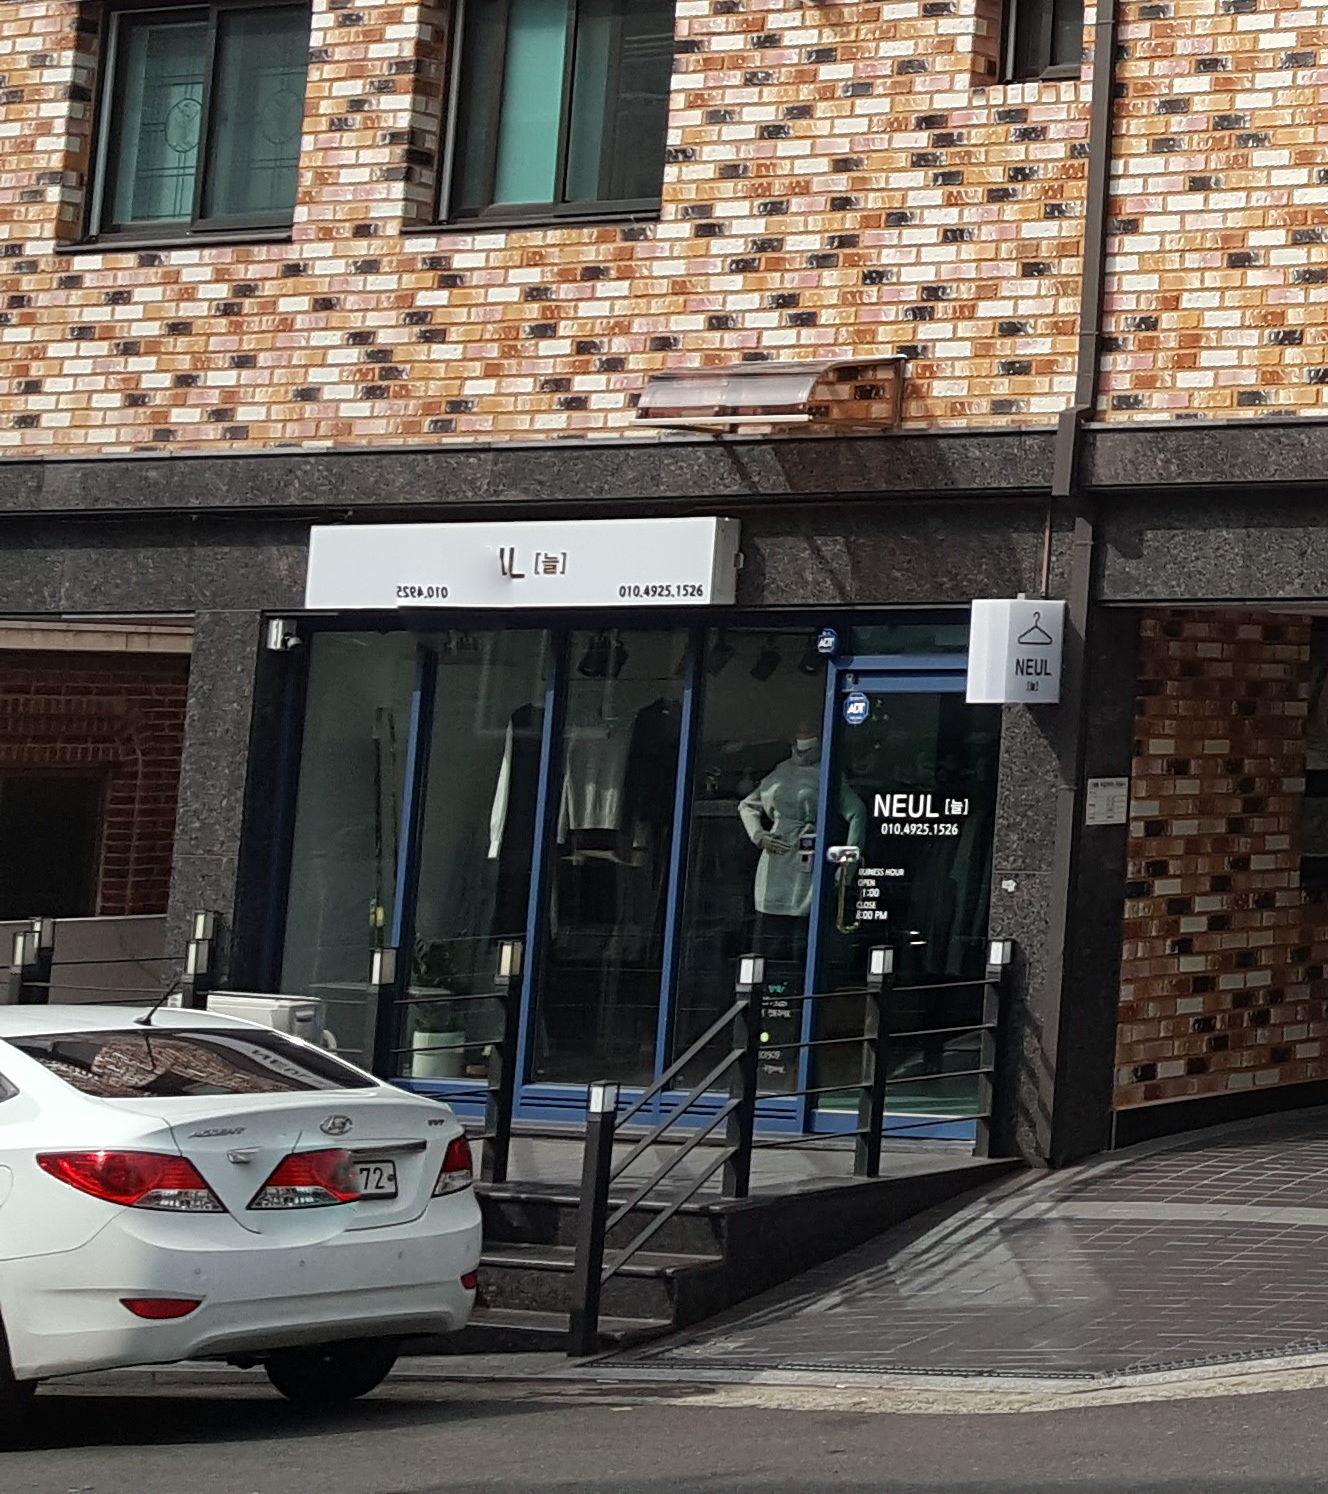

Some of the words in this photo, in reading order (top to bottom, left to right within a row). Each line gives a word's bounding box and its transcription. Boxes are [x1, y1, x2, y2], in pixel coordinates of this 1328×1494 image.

[618, 584, 704, 598] 010.4925.1526
[1015, 658, 1051, 676] NEUL
[847, 702, 866, 714] ADT
[873, 794, 940, 818] NEUL
[944, 798, 969, 816] [늘]
[881, 823, 959, 836] 010.4925.1526
